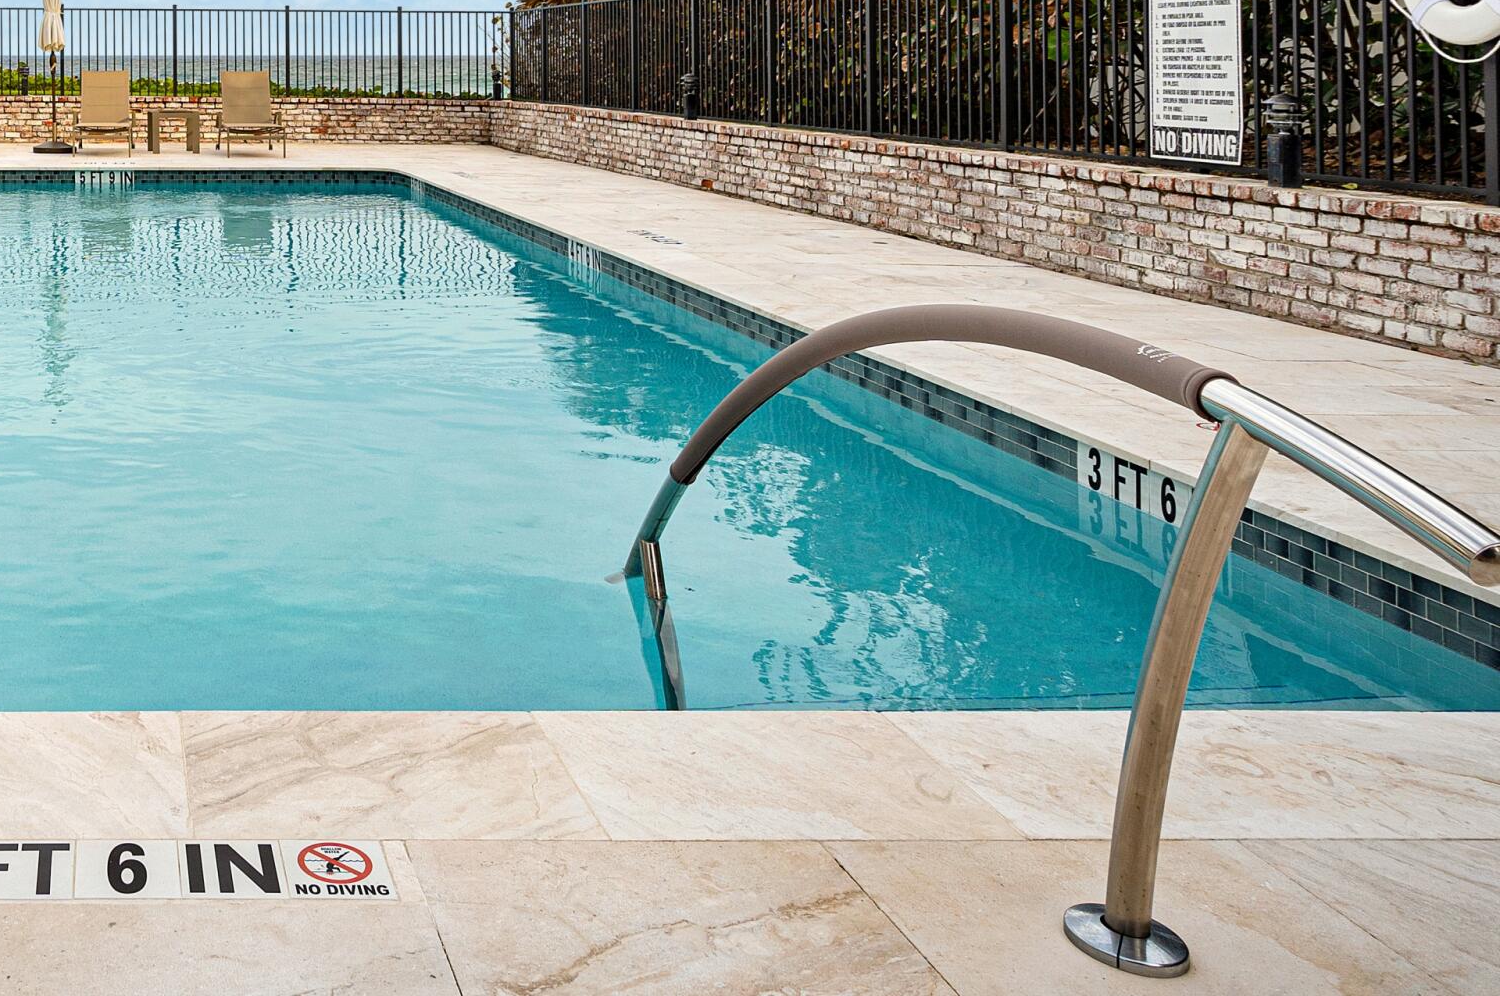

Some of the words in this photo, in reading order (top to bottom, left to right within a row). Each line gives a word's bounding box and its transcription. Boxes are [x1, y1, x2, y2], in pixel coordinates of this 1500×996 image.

[1155, 130, 1177, 153] NO
[1181, 132, 1237, 157] DIVING
[80, 171, 86, 184] 5
[90, 171, 104, 184] FT
[109, 171, 115, 184] 9
[120, 171, 133, 184] IN
[592, 249, 601, 271] IN
[1088, 447, 1101, 490] 3
[1114, 456, 1148, 510] FT
[1161, 477, 1176, 523] 6
[106, 843, 148, 894] 6
[185, 843, 281, 894] IN
[295, 884, 321, 895] NO
[326, 884, 390, 895] DIVING
